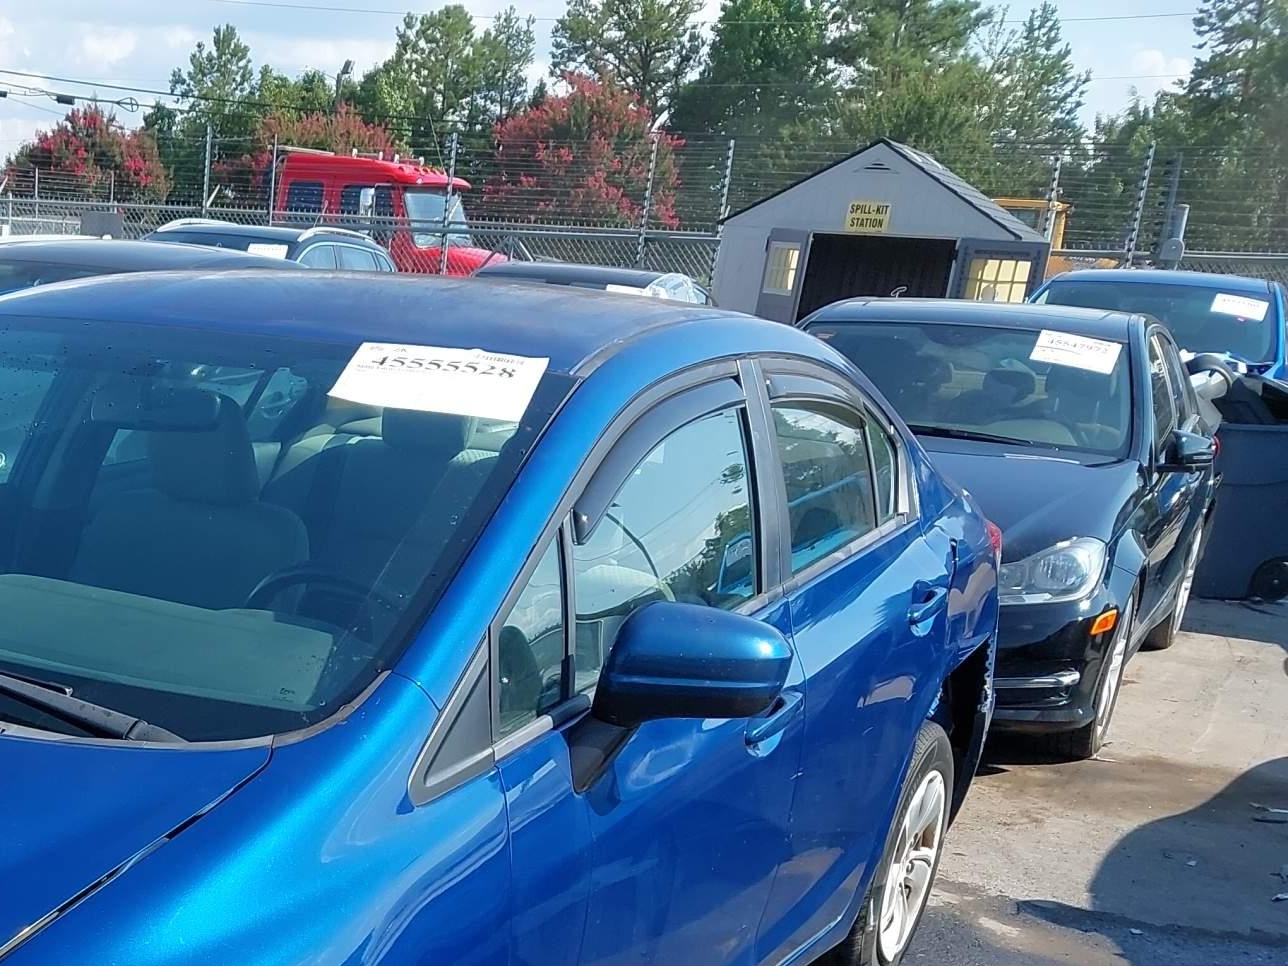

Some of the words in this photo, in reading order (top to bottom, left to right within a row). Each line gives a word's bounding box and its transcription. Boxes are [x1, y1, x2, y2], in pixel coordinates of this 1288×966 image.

[849, 203, 890, 215] SPILL-KIT
[849, 216, 884, 228] STATION
[372, 355, 516, 378] 45555528
